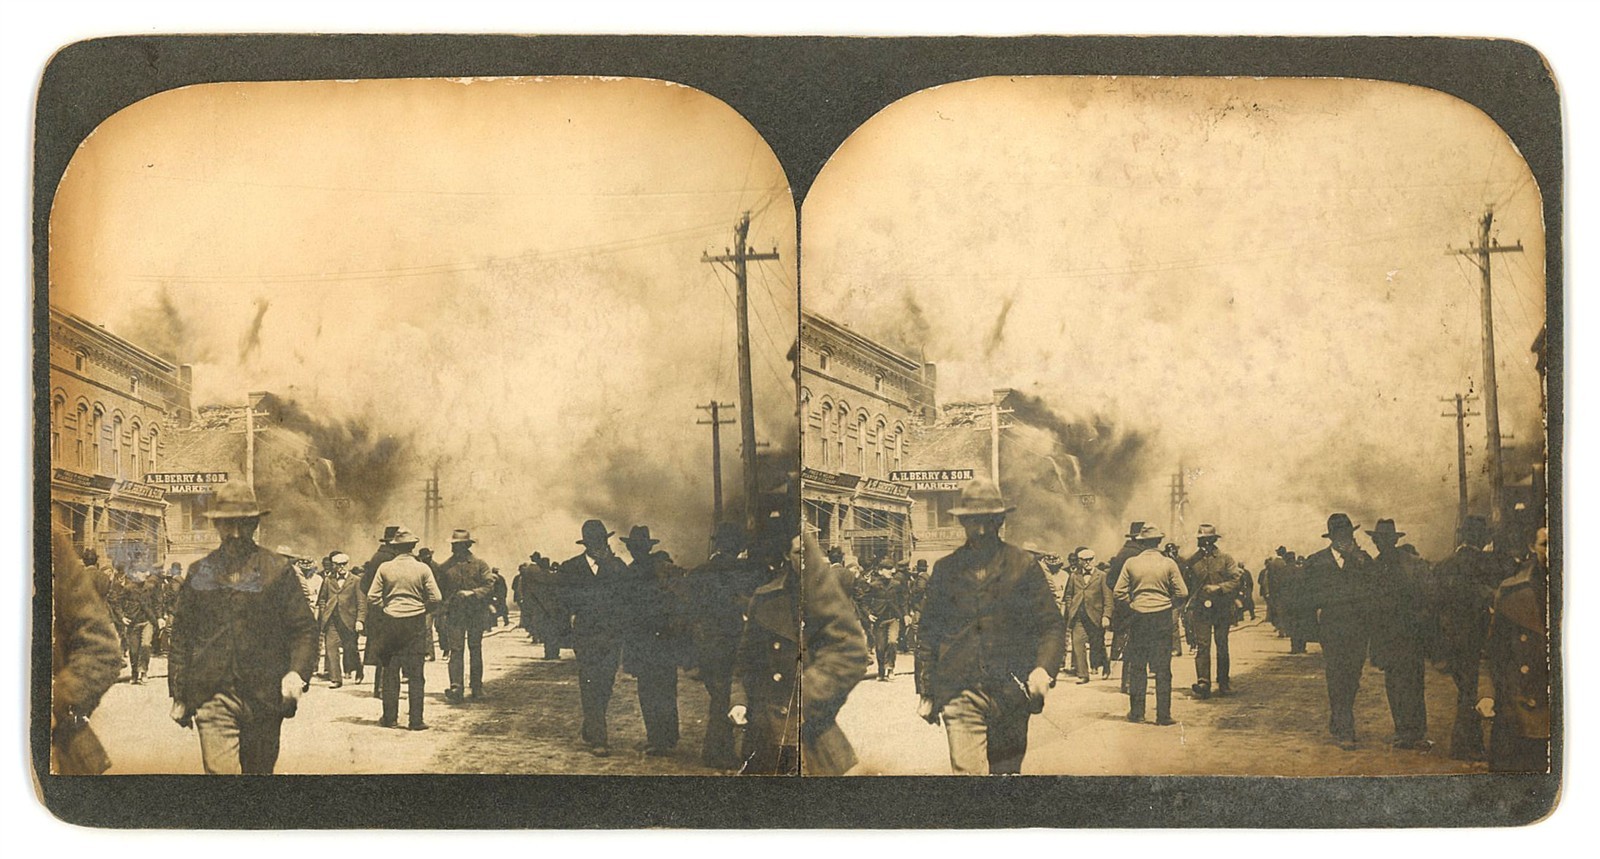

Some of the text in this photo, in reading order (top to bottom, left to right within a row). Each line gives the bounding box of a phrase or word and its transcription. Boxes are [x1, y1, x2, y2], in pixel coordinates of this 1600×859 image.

[196, 474, 204, 483] &
[941, 471, 949, 480] &
[171, 484, 213, 493] MARKET
[916, 482, 958, 491] MARKET
